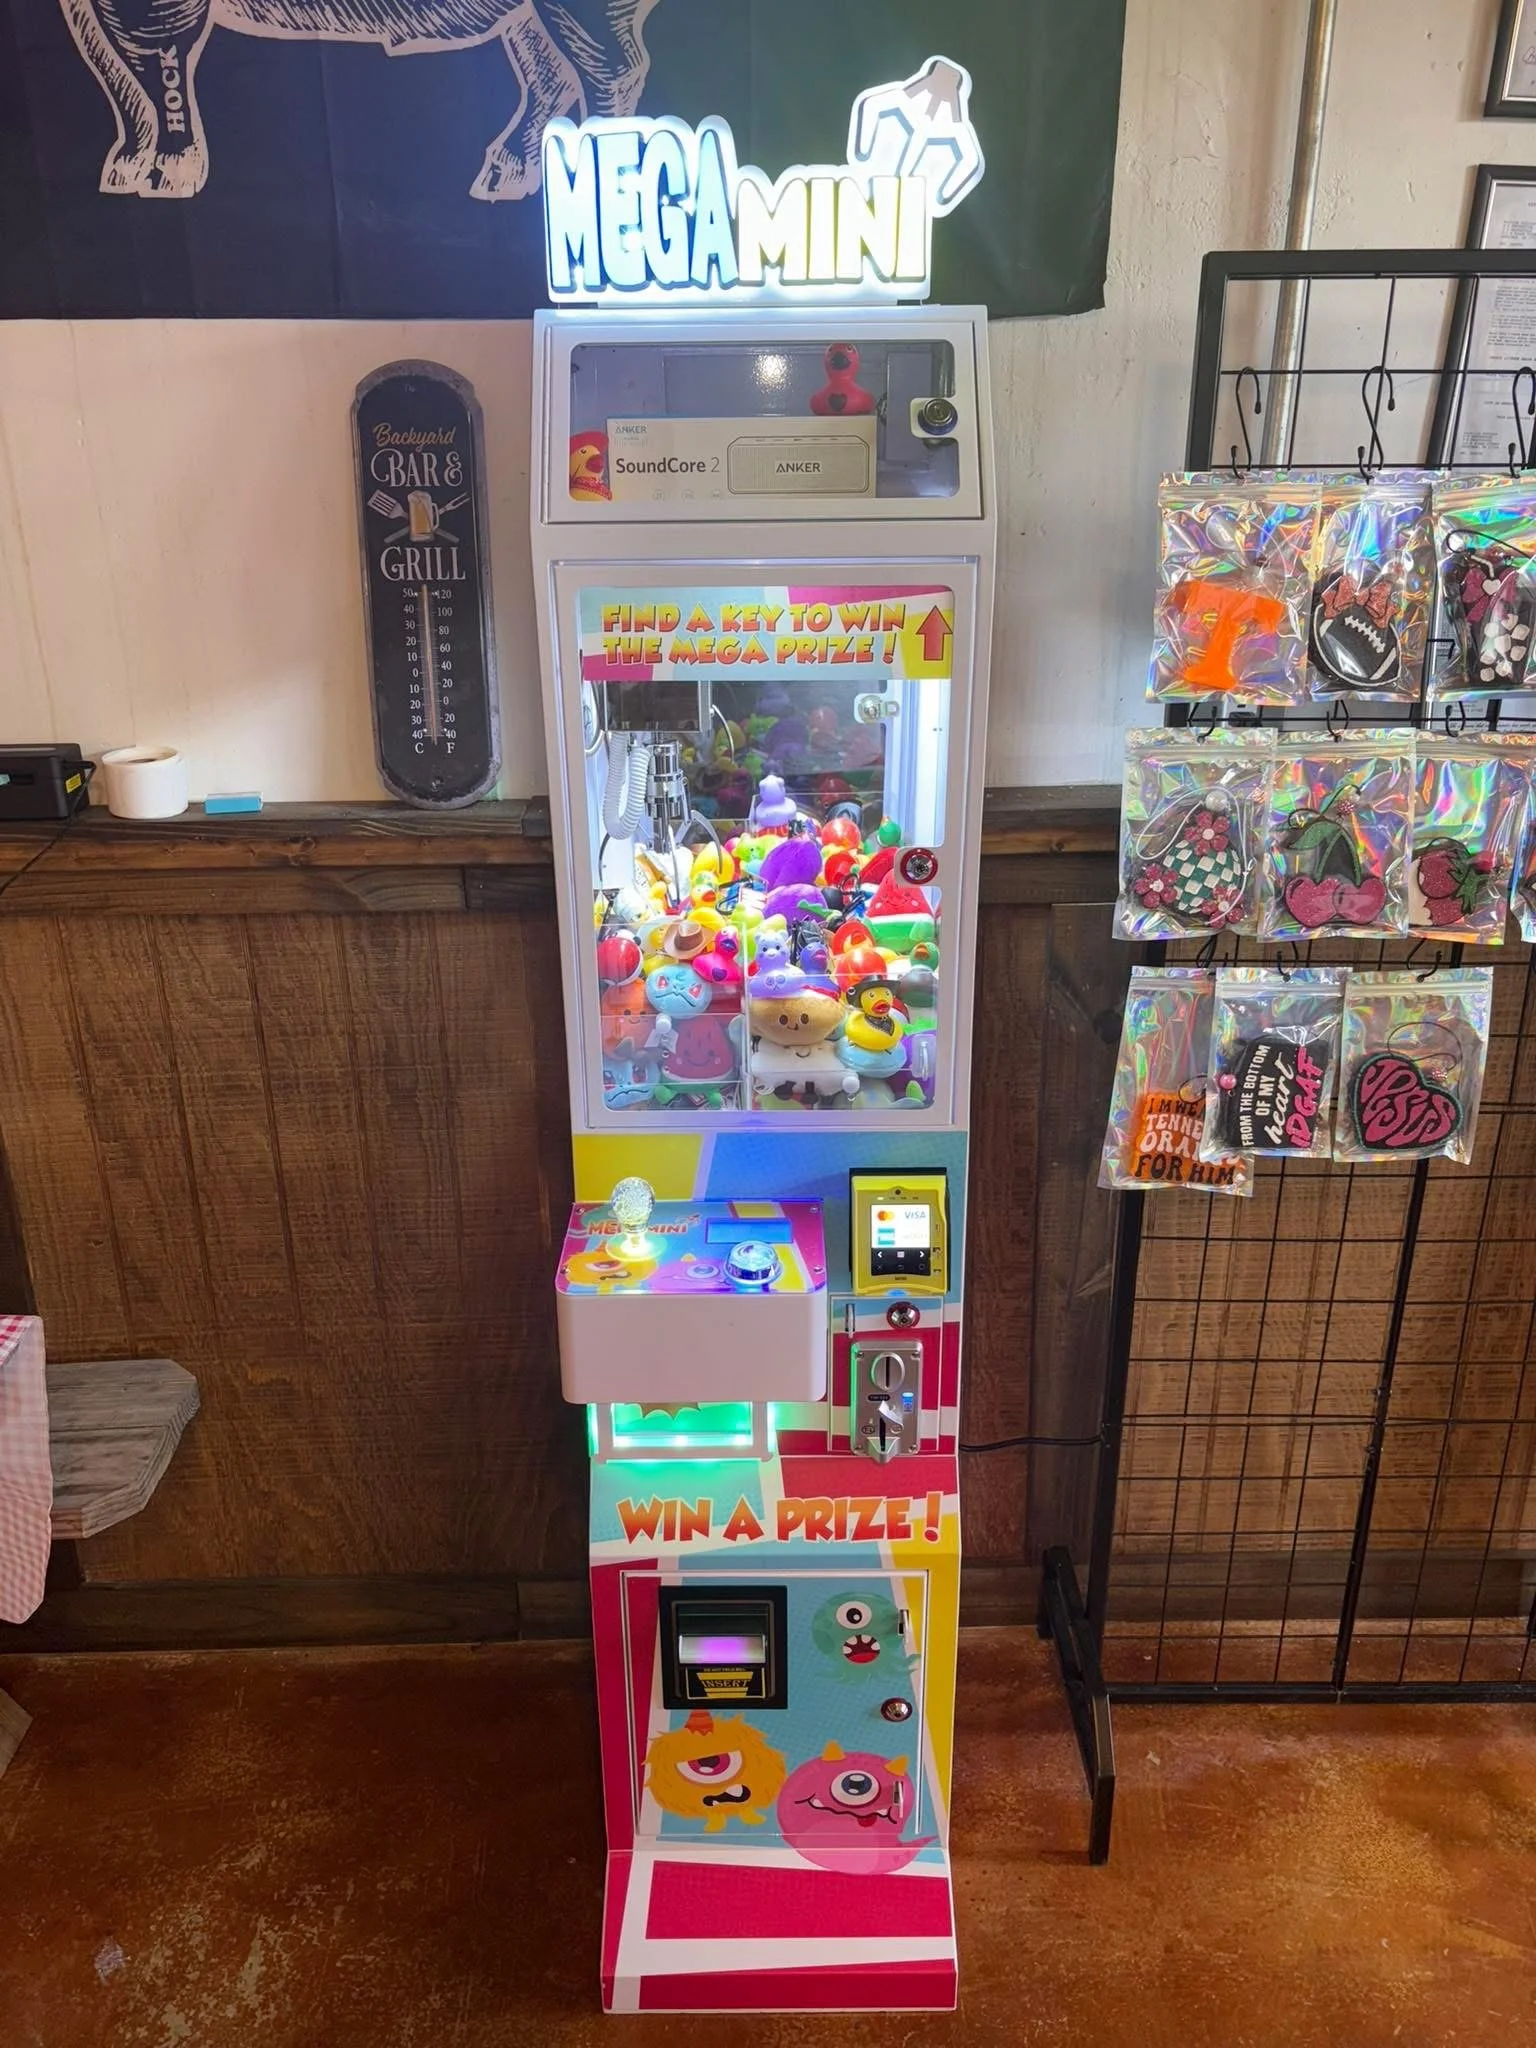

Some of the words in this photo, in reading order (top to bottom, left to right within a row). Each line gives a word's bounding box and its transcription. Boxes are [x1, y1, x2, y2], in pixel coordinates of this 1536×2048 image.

[159, 44, 186, 133] HOCK
[546, 129, 738, 293] MEGA
[736, 176, 927, 285] MINI
[615, 425, 648, 434] ANKER
[373, 422, 456, 453] Backyard
[371, 448, 440, 487] BAR
[444, 451, 463, 487] &
[615, 457, 706, 474] SoundCore
[710, 457, 720, 473] 2
[776, 462, 822, 473] ANKER
[380, 546, 466, 581] GRILL
[402, 588, 413, 598] 50
[403, 604, 414, 614] 40
[437, 607, 453, 617] 100
[603, 604, 681, 633] FIND
[686, 605, 715, 633] A
[722, 604, 784, 633] KEY
[790, 604, 833, 633] TO
[837, 604, 907, 633] WIN
[404, 620, 415, 630] 30
[438, 625, 449, 635] 80
[405, 636, 417, 646] 20
[440, 643, 451, 653] 60
[604, 636, 662, 666] THE
[668, 637, 770, 665] MEGA
[407, 652, 418, 661] 10
[441, 660, 452, 670] 40
[442, 678, 453, 688] 20
[409, 684, 420, 694] 10
[410, 699, 421, 709] 20
[443, 696, 449, 705] 0
[411, 715, 422, 725] 30
[444, 713, 455, 723] 20
[412, 730, 423, 740] 40
[445, 729, 457, 739] 40
[415, 742, 424, 754] C
[446, 742, 456, 754] F
[1243, 1044, 1271, 1089] BOTTOM
[1258, 1075, 1275, 1096] MY
[1241, 1092, 1254, 1112] THE
[1264, 1051, 1294, 1145] heart
[1285, 1045, 1324, 1149] IDGAF
[1255, 1100, 1271, 1116] OF
[1146, 1113, 1204, 1140] TENNE
[1240, 1115, 1254, 1146] FROM
[1134, 1153, 1183, 1181] FOR
[1190, 1162, 1236, 1185] HIM
[904, 1210, 926, 1220] VISA
[616, 1495, 713, 1545] WIN
[722, 1494, 765, 1542] A
[701, 1680, 748, 1688] INSERT
